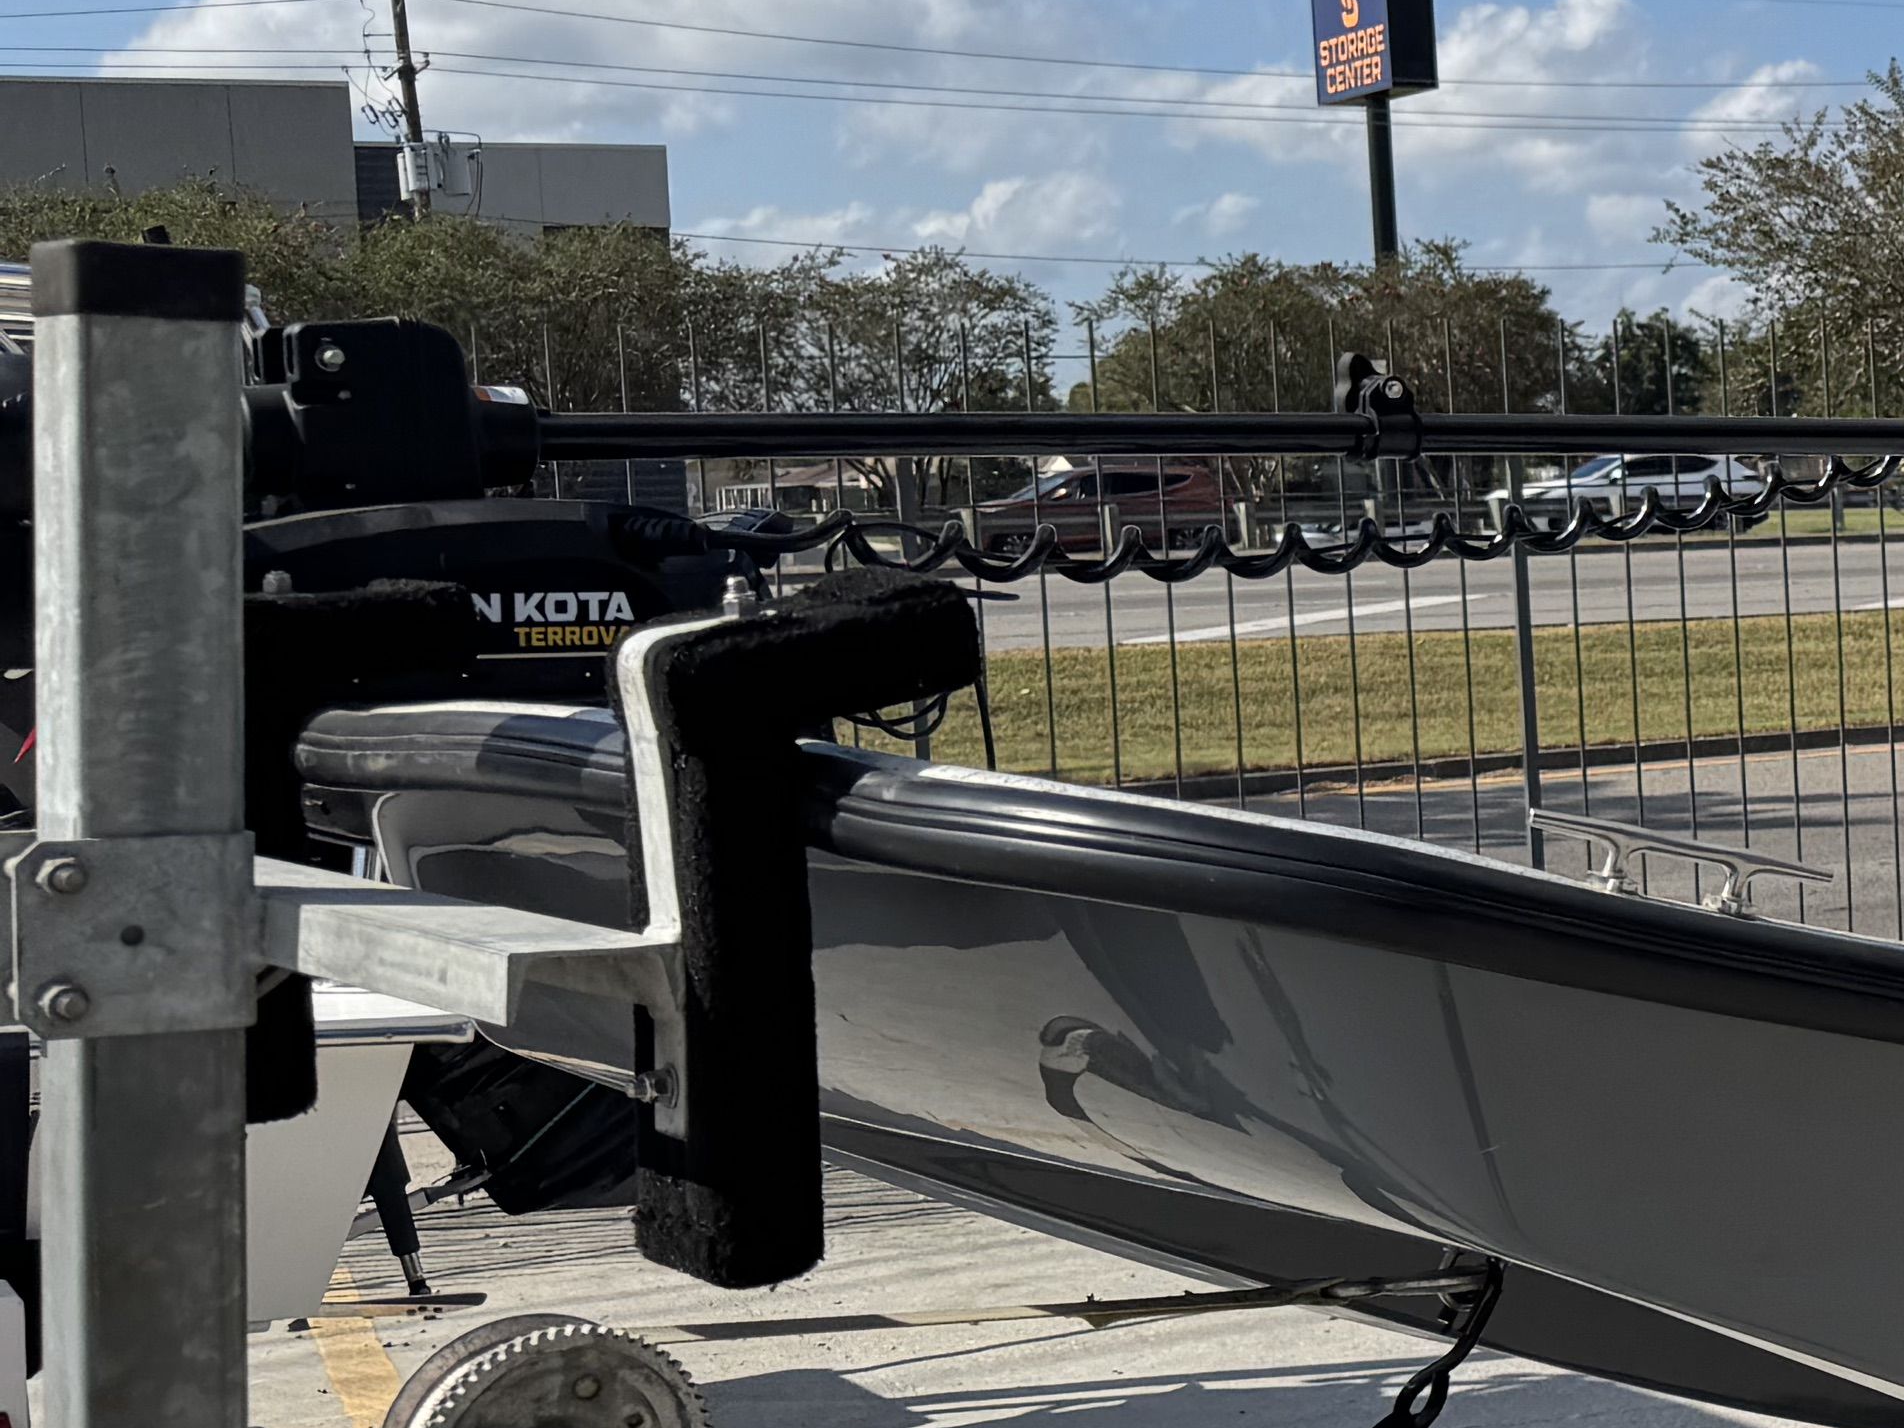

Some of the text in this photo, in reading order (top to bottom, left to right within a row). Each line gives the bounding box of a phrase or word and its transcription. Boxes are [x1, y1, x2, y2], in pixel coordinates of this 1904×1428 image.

[1319, 23, 1386, 68] STORAGE
[1326, 55, 1382, 95] CENTER
[513, 591, 636, 623] KOTA
